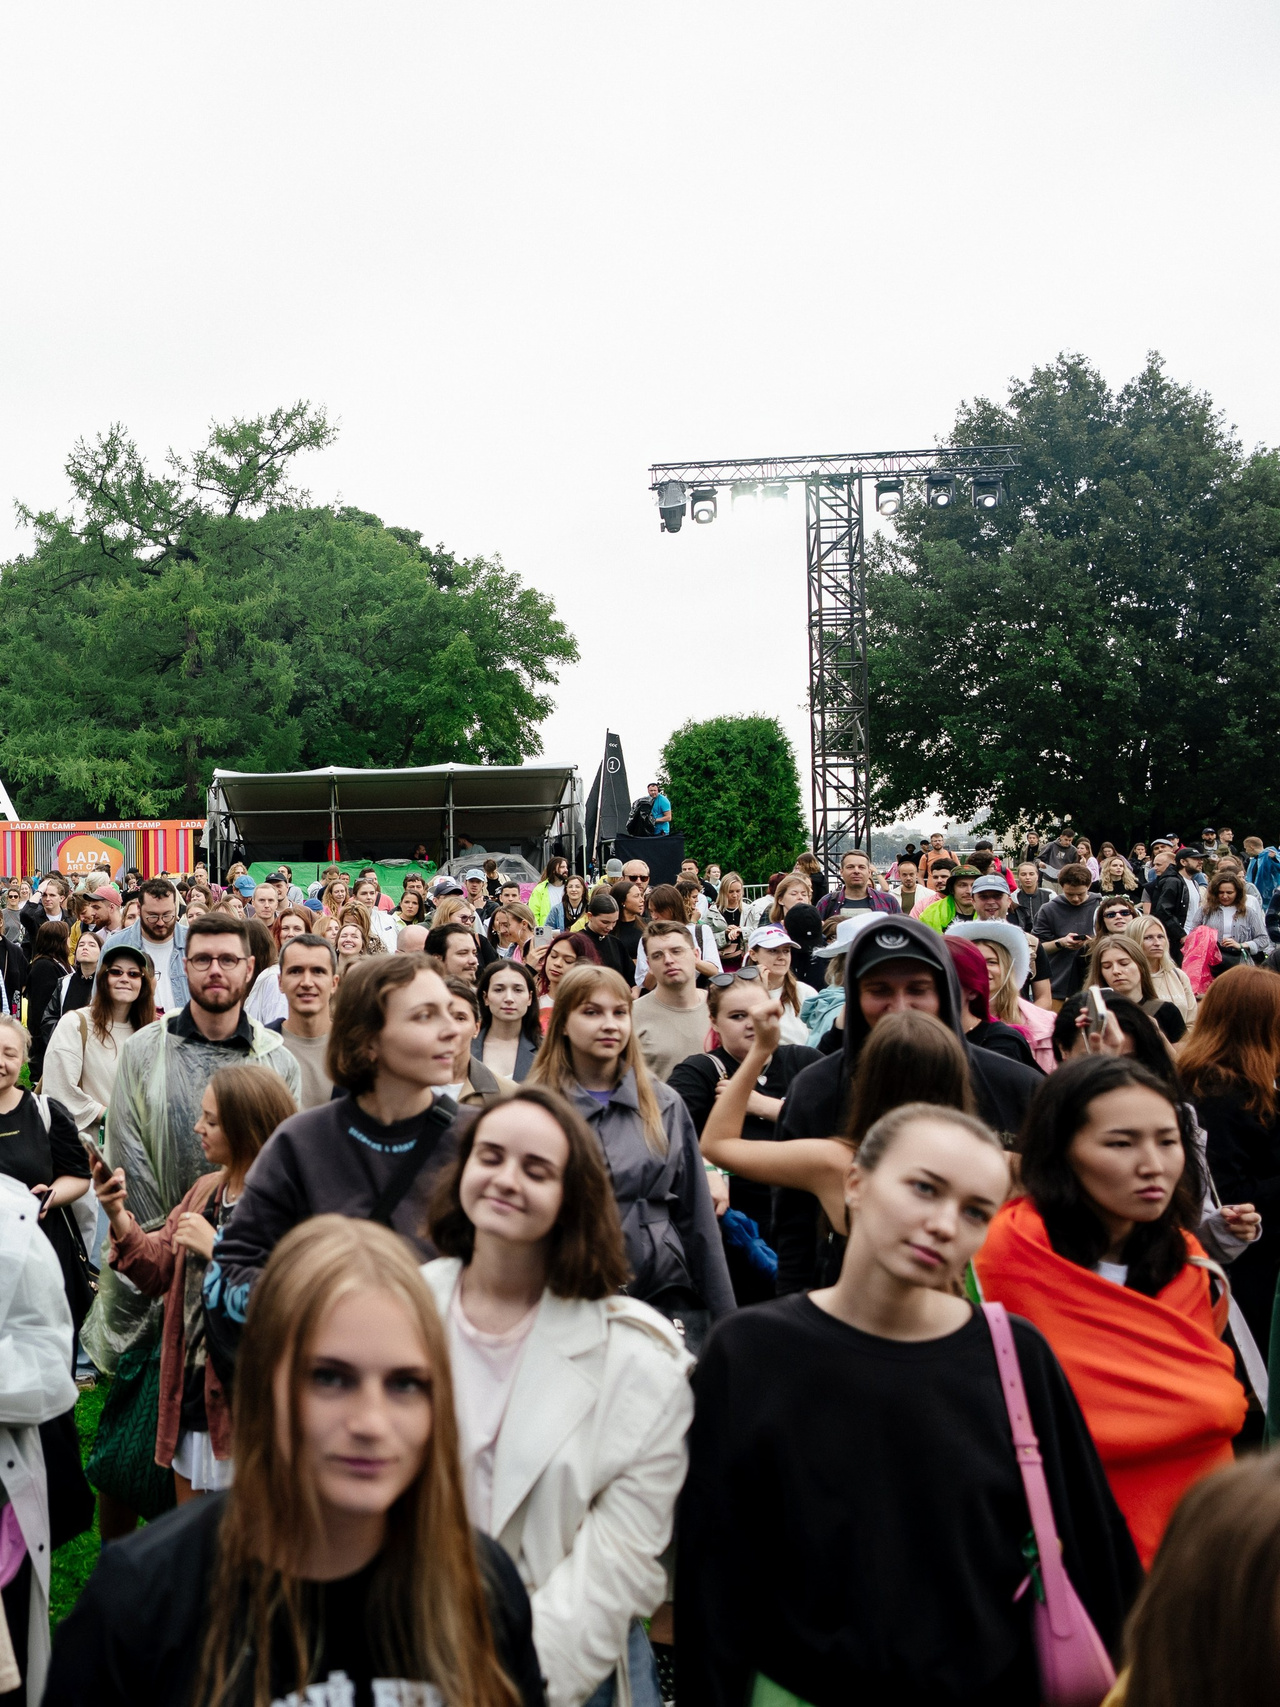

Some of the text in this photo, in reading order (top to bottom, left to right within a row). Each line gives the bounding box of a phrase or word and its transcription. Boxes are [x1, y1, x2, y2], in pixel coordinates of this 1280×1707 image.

[136, 821, 161, 829] CAMP
[66, 851, 111, 864] LADA
[67, 863, 84, 871] ART
